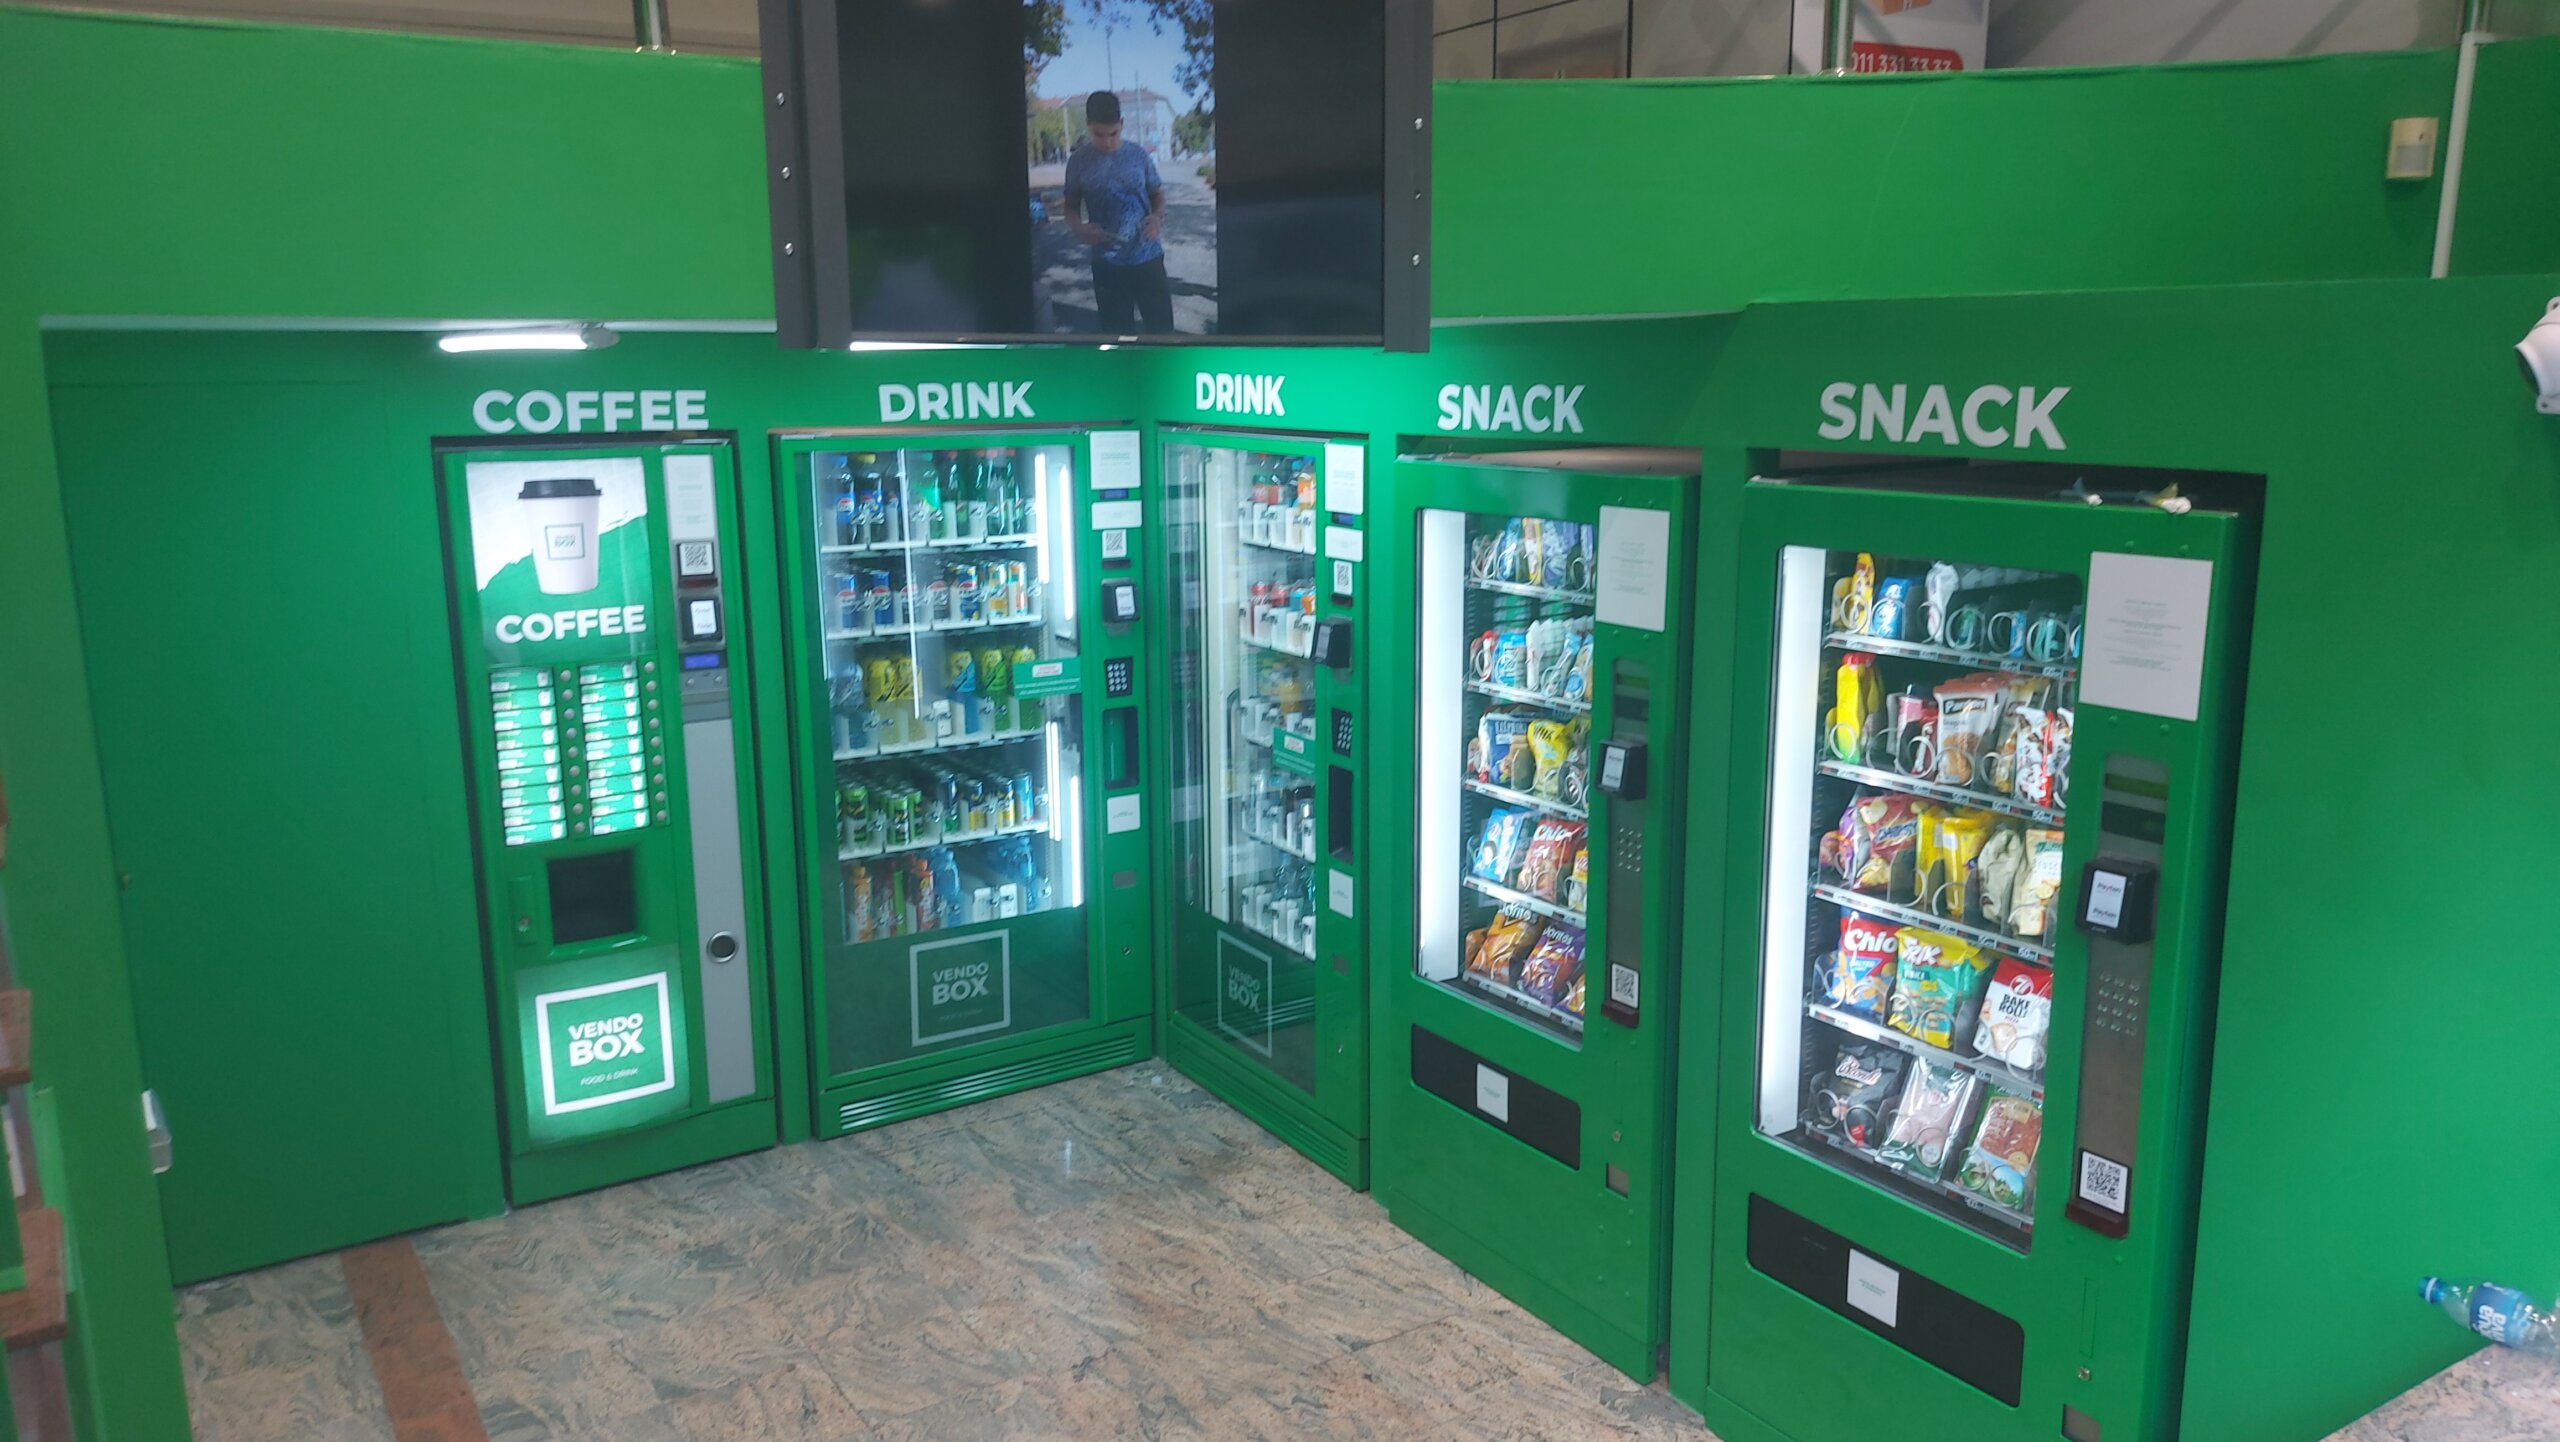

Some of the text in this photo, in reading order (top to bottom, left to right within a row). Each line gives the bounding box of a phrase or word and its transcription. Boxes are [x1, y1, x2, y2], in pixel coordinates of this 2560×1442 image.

[472, 389, 709, 434] COFFEE
[878, 381, 1036, 422] DRINK
[1195, 372, 1286, 417] DRINK
[1437, 384, 1586, 433] SNACK
[1817, 382, 2071, 450] SNACK
[495, 604, 646, 644] COFFEE
[1844, 928, 1898, 953] Chio
[932, 961, 989, 983] VENDO
[933, 975, 990, 1006] BOX
[1228, 964, 1260, 992] VENDO
[1229, 979, 1260, 1013] BOX
[567, 1012, 644, 1040] VENDO
[569, 1027, 645, 1067] BOX
